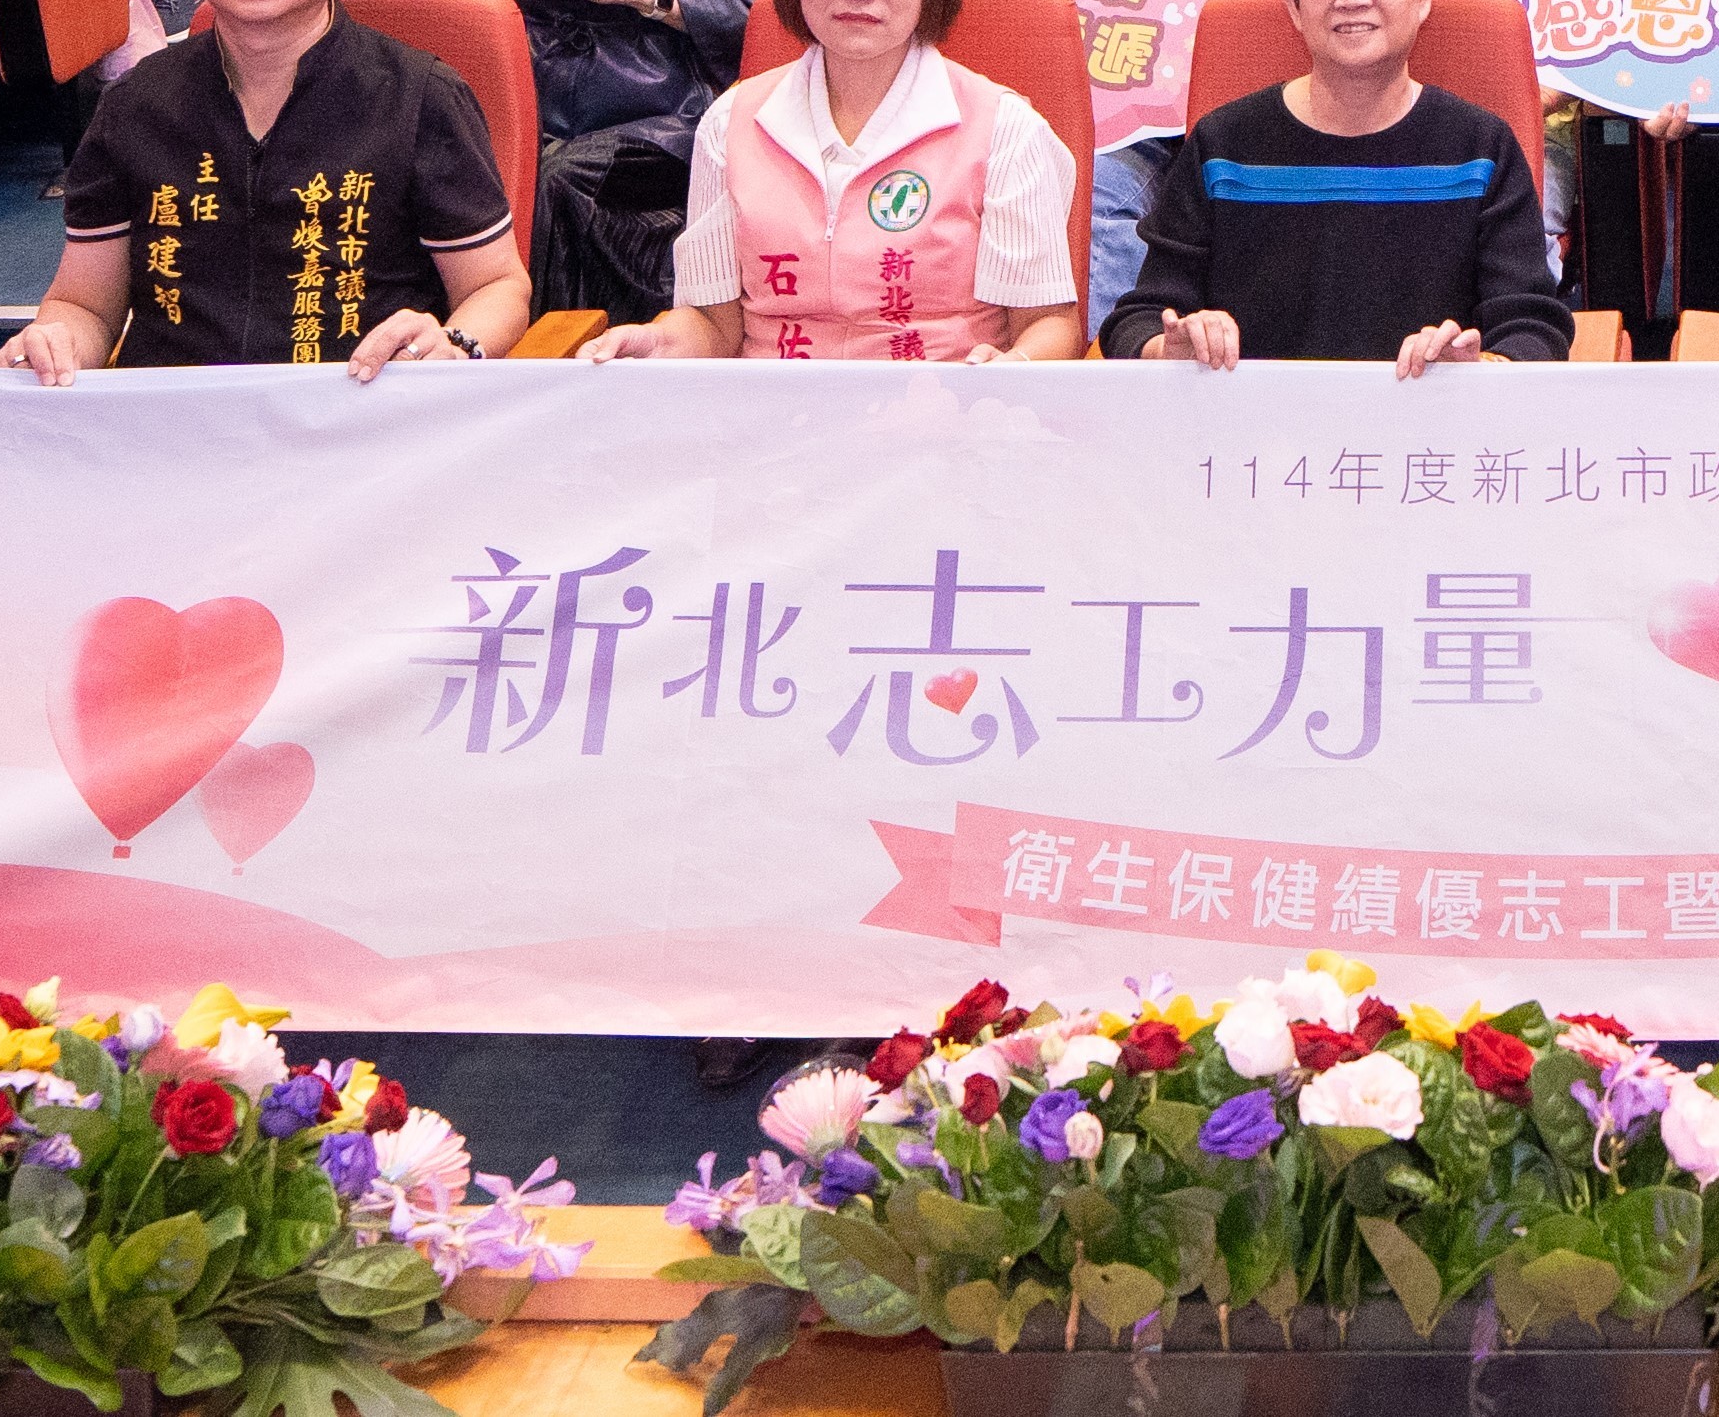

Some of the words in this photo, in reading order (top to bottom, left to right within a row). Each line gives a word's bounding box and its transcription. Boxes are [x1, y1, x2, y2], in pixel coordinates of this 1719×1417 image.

[147, 183, 184, 326] 盧建智
[191, 151, 220, 222] 主任
[335, 168, 375, 340] 新北市議員
[412, 546, 1570, 767] 新北志工力量
